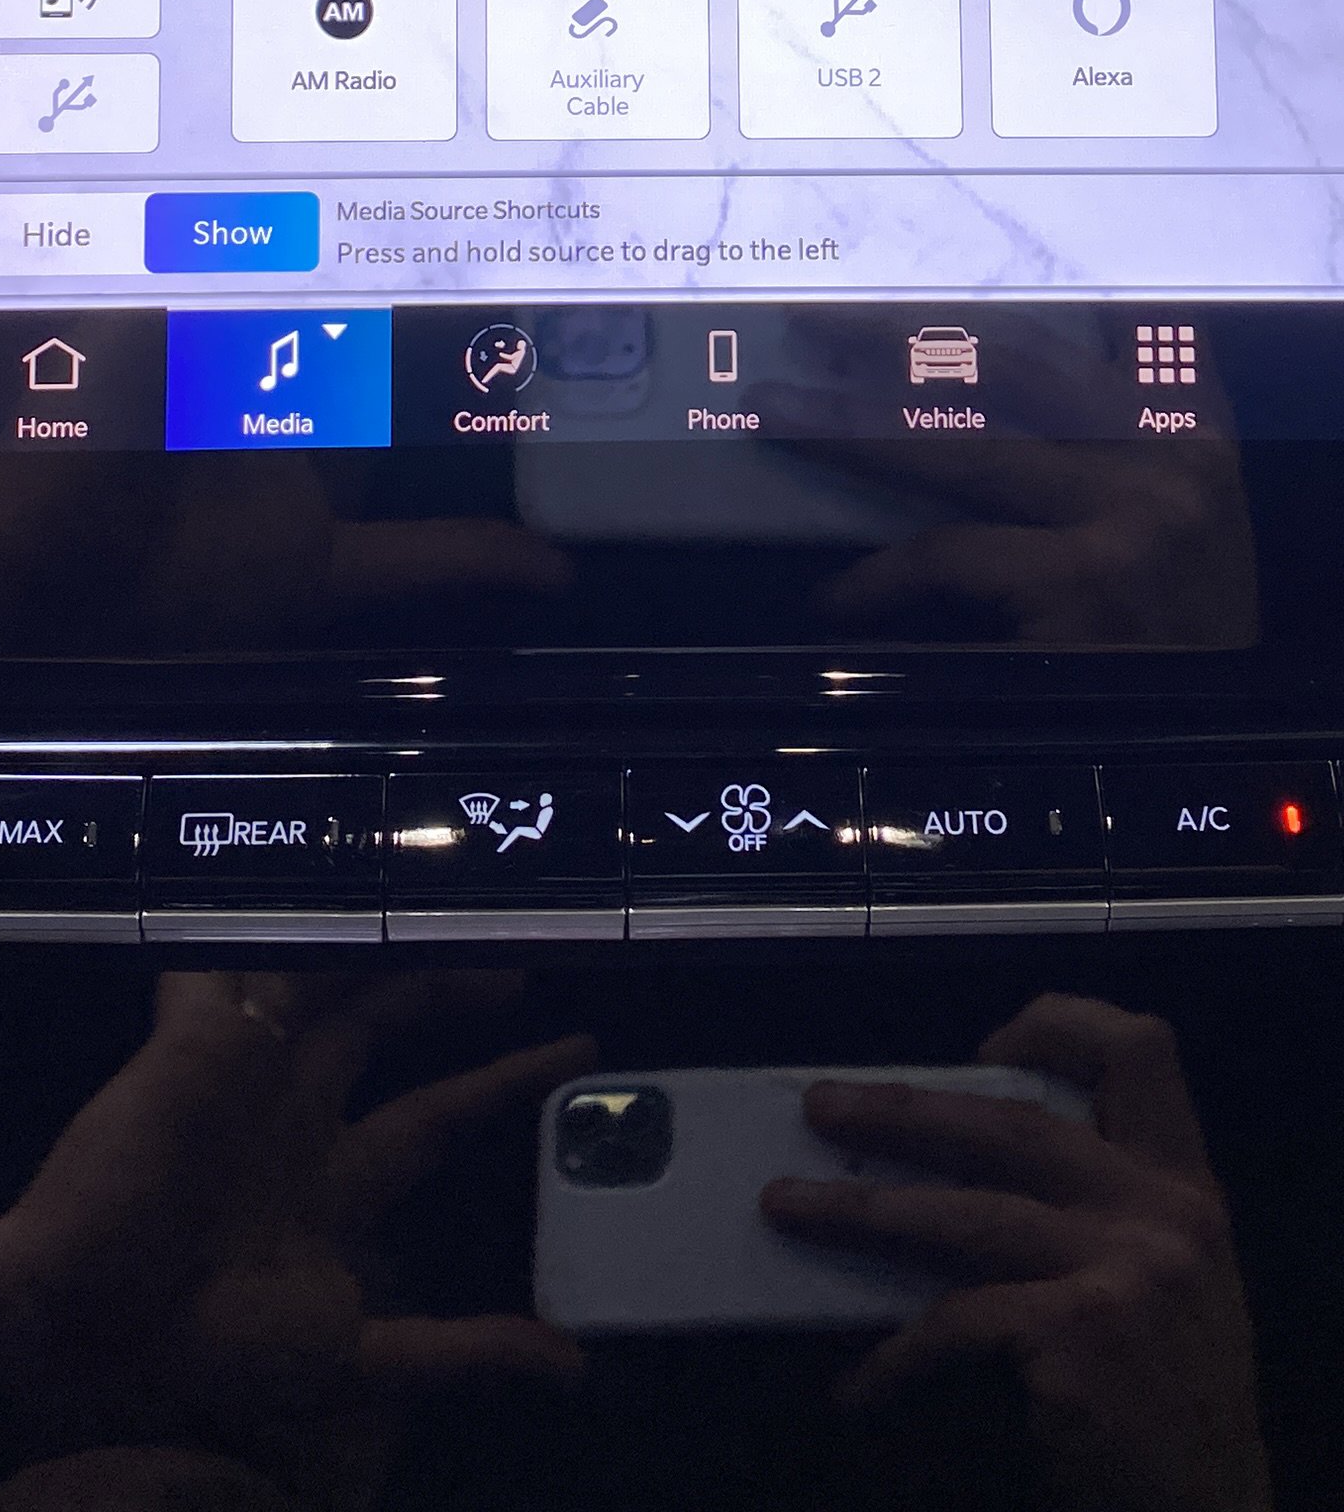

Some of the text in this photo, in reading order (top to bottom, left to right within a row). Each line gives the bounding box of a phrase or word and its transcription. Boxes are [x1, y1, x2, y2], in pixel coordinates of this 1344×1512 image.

[322, 2, 365, 22] AM
[291, 69, 397, 91] AM Radio
[550, 68, 645, 93] Auxiliary
[818, 67, 882, 87] USB 2
[1072, 66, 1133, 86] Alexa
[566, 95, 629, 116] Cable
[337, 199, 601, 221] Media Source Shortcuts
[23, 221, 91, 248] Hide
[193, 219, 273, 245] Show
[338, 237, 840, 267] Press and hold source to drag to the left
[17, 417, 89, 439] Home
[243, 412, 314, 435] Media
[454, 409, 550, 432] Comfort
[688, 408, 760, 430] Phone
[902, 406, 986, 429] Vehicle
[1138, 407, 1197, 433] Apps
[923, 809, 1008, 837] AUTO
[1177, 805, 1231, 832] A/C
[233, 820, 307, 846] REAR
[728, 833, 768, 852] OFF
